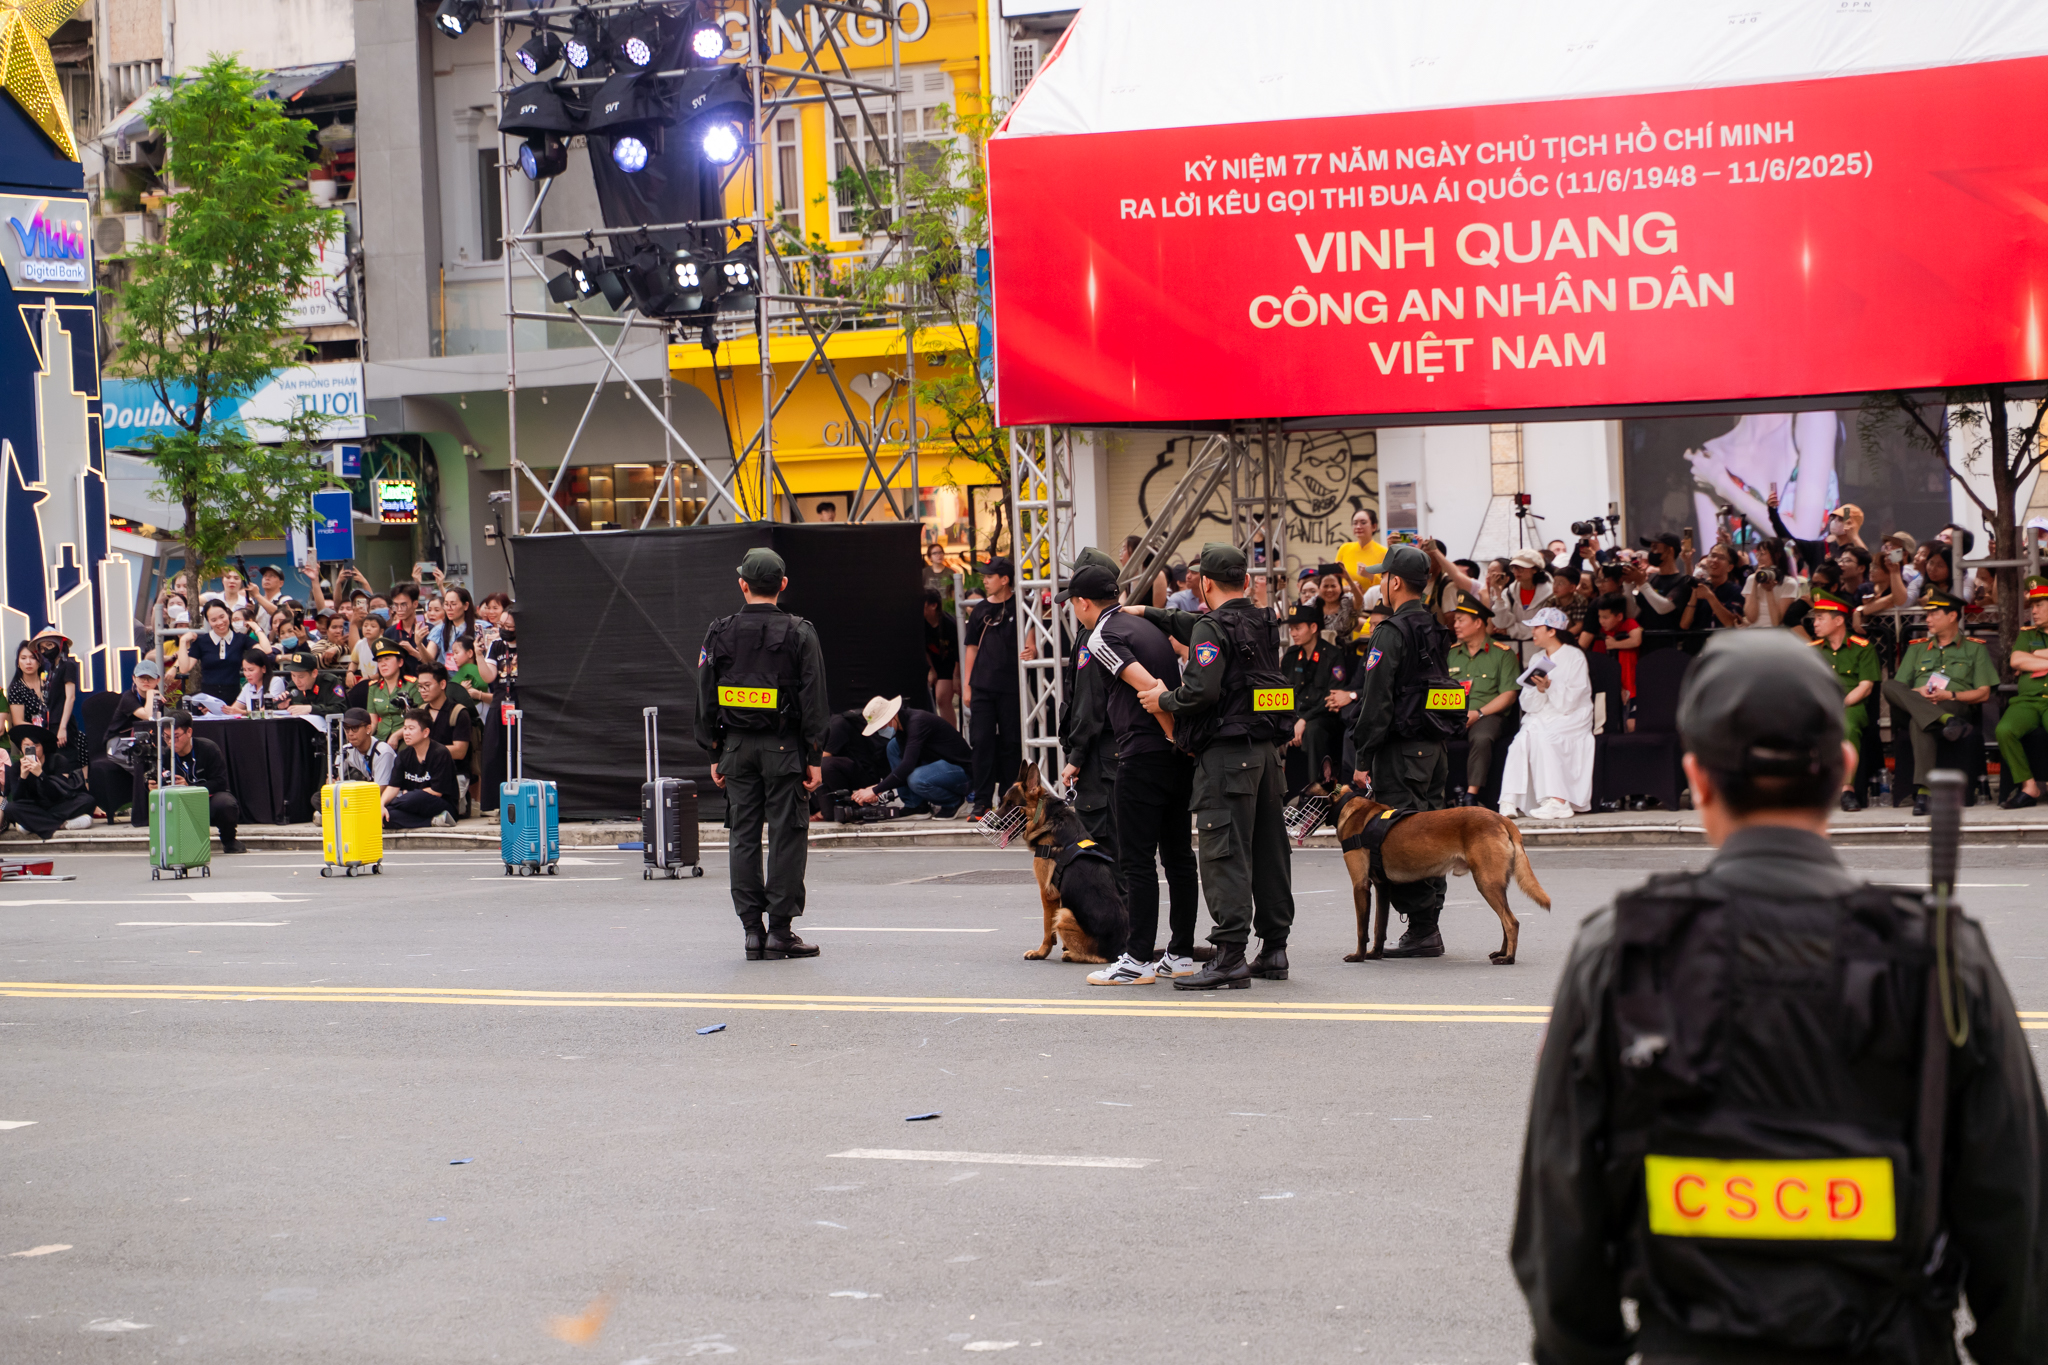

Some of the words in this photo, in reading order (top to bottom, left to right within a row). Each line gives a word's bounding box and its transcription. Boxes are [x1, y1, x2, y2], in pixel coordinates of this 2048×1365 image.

[716, 0, 930, 59] GNKGO
[520, 104, 538, 114] SVT
[605, 101, 620, 114] SVT
[1185, 155, 1217, 182] KỶ
[1223, 153, 1287, 183] NIỆM
[1293, 153, 1323, 175] 77
[1330, 146, 1389, 174] NĂM
[1396, 141, 1471, 170] NGÀY
[1477, 135, 1536, 165] CHỦ
[1542, 134, 1608, 163] TỊCH
[1615, 121, 1657, 154] HỒ
[1664, 121, 1714, 151] CHÍ
[1720, 121, 1794, 148] MINH
[1121, 198, 1156, 219] RA
[1162, 191, 1201, 218] LỜI
[1208, 188, 1261, 216] KÊU
[1267, 189, 1315, 216] GỌI
[1321, 186, 1364, 209] THI
[1369, 184, 1429, 207] ĐUA
[1434, 177, 1460, 204] ÁI
[1466, 167, 1549, 204] QUỐC
[1556, 164, 1697, 199] (11/6/1948
[1728, 151, 1873, 184] 11/6/2025)
[8, 200, 84, 259] Vikki
[1295, 226, 1435, 274] VINH
[1456, 212, 1678, 269] QUANG
[26, 264, 58, 279] Digital
[60, 265, 83, 278] Bank
[310, 303, 326, 316] 079
[1249, 284, 1388, 329] CÔNG
[1398, 287, 1464, 323] AN
[1476, 271, 1617, 319] NHÂN
[1628, 265, 1735, 311] DÂN
[1369, 331, 1474, 383] VIỆT
[1491, 332, 1606, 372] NAM
[724, 689, 771, 704] CSCĐ
[1258, 693, 1289, 707] CSCĐ
[1432, 693, 1461, 706] CSCĐ
[1672, 1173, 1864, 1222] CSCĐ
